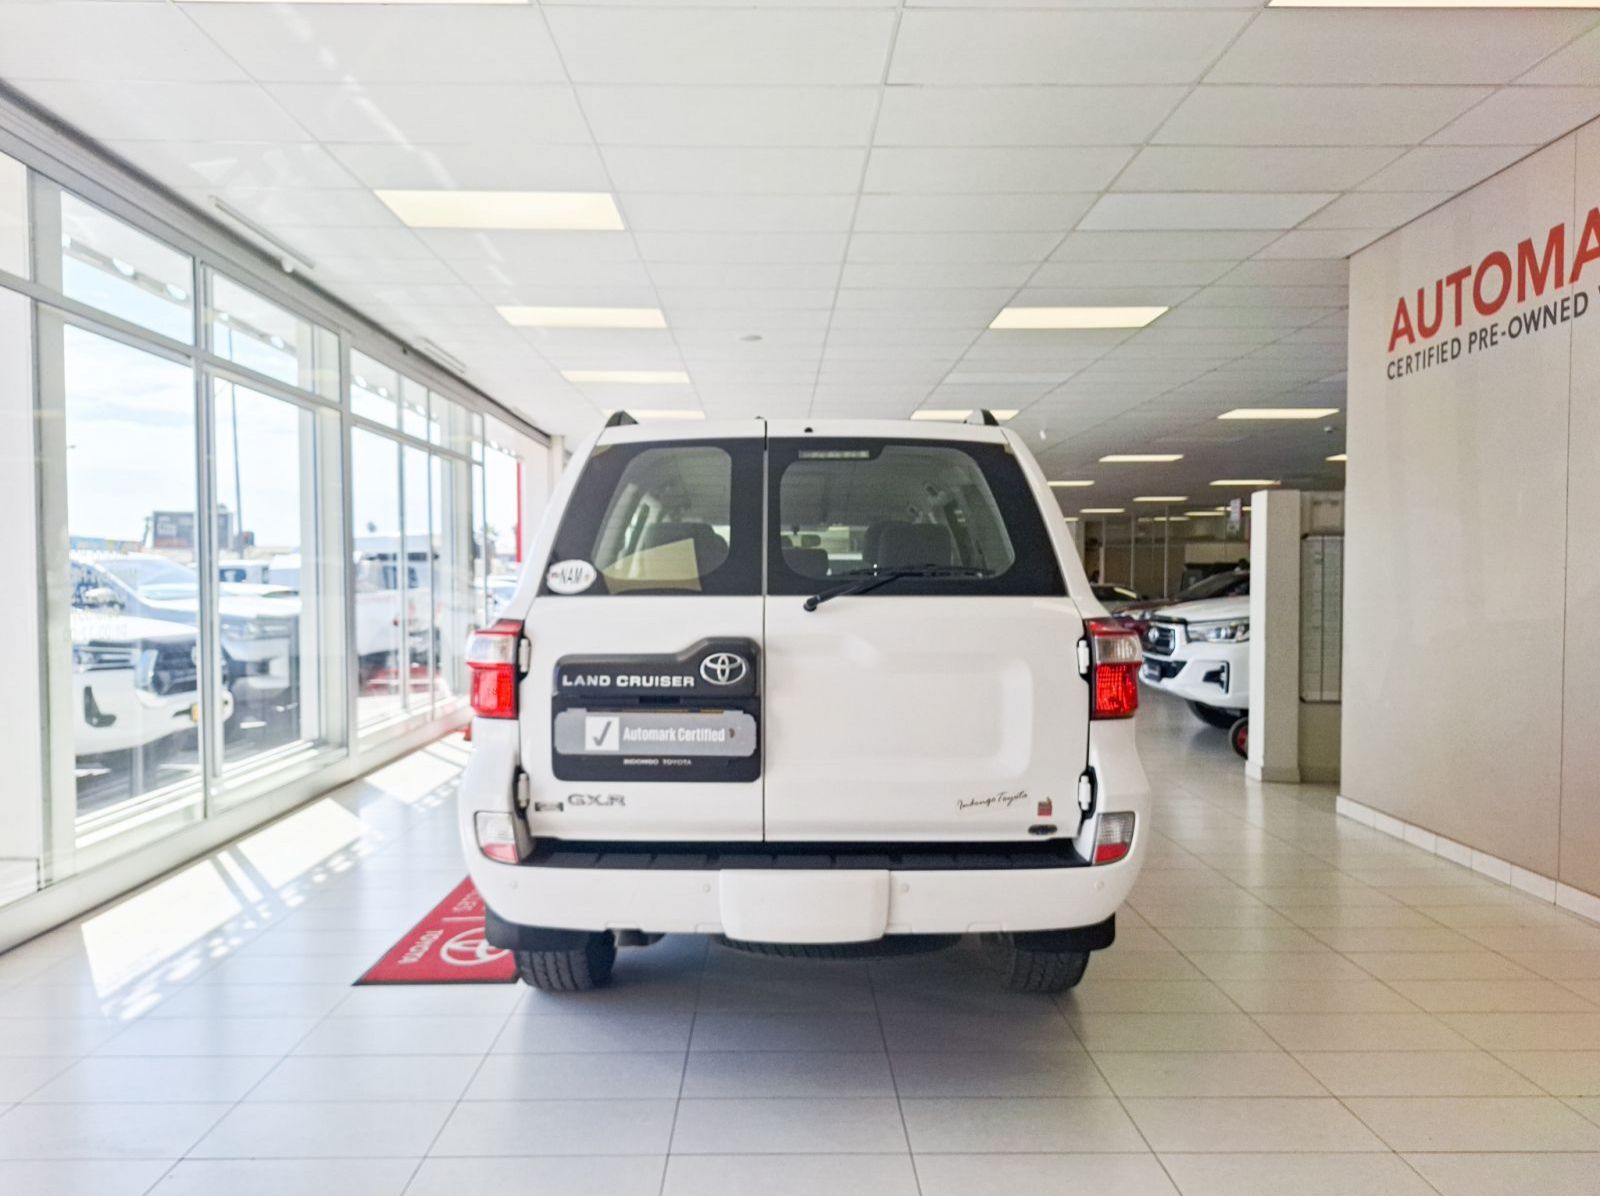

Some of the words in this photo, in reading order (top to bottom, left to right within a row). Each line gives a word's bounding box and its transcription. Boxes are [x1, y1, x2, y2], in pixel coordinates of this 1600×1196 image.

[1387, 338, 1461, 380] CERTIFIED
[1468, 292, 1588, 353] PRE-OWNED
[562, 675, 611, 687] LAND
[616, 675, 695, 687] CRUISER
[623, 727, 675, 741] Automark
[678, 728, 725, 742] Certified
[997, 790, 1028, 807] Toyota
